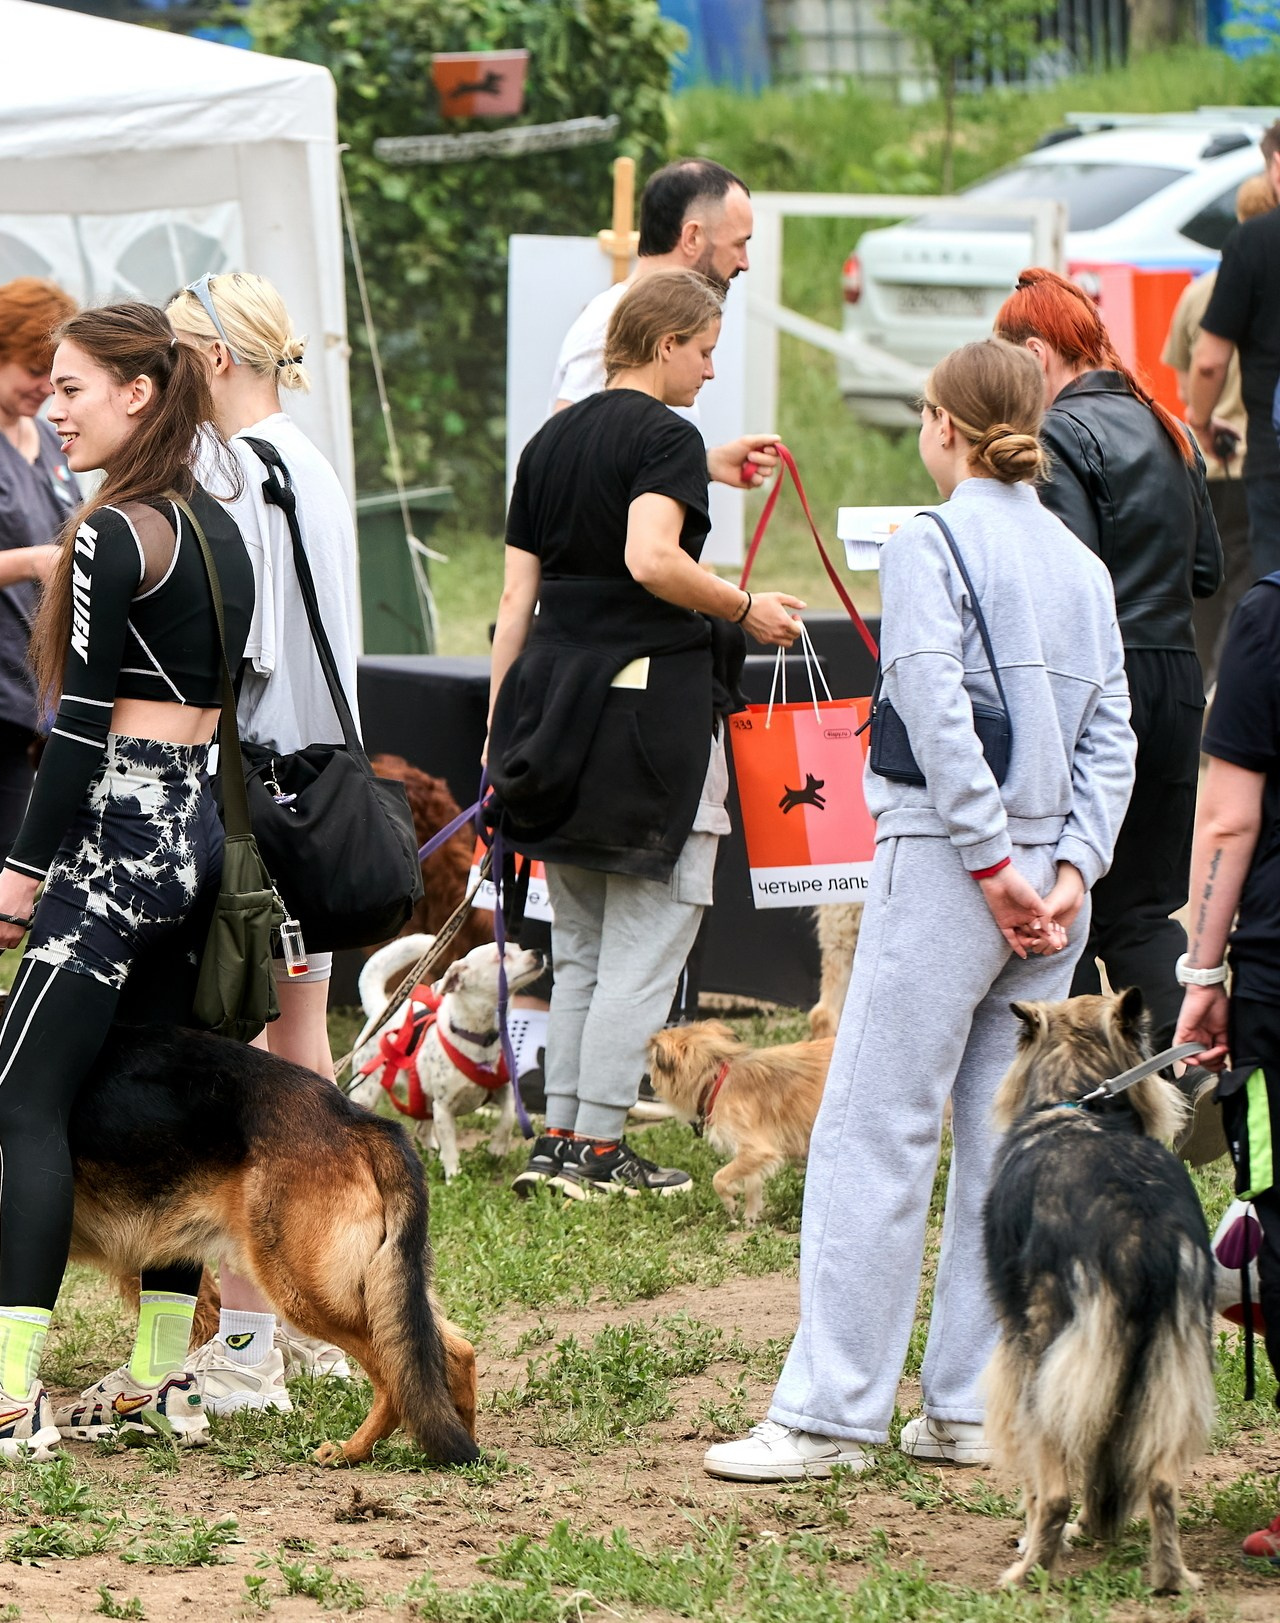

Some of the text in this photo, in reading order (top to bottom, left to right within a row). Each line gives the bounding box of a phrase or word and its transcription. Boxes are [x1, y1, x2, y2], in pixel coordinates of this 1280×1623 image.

[71, 521, 98, 665] KL ALIEN
[758, 879, 823, 895] четыре
